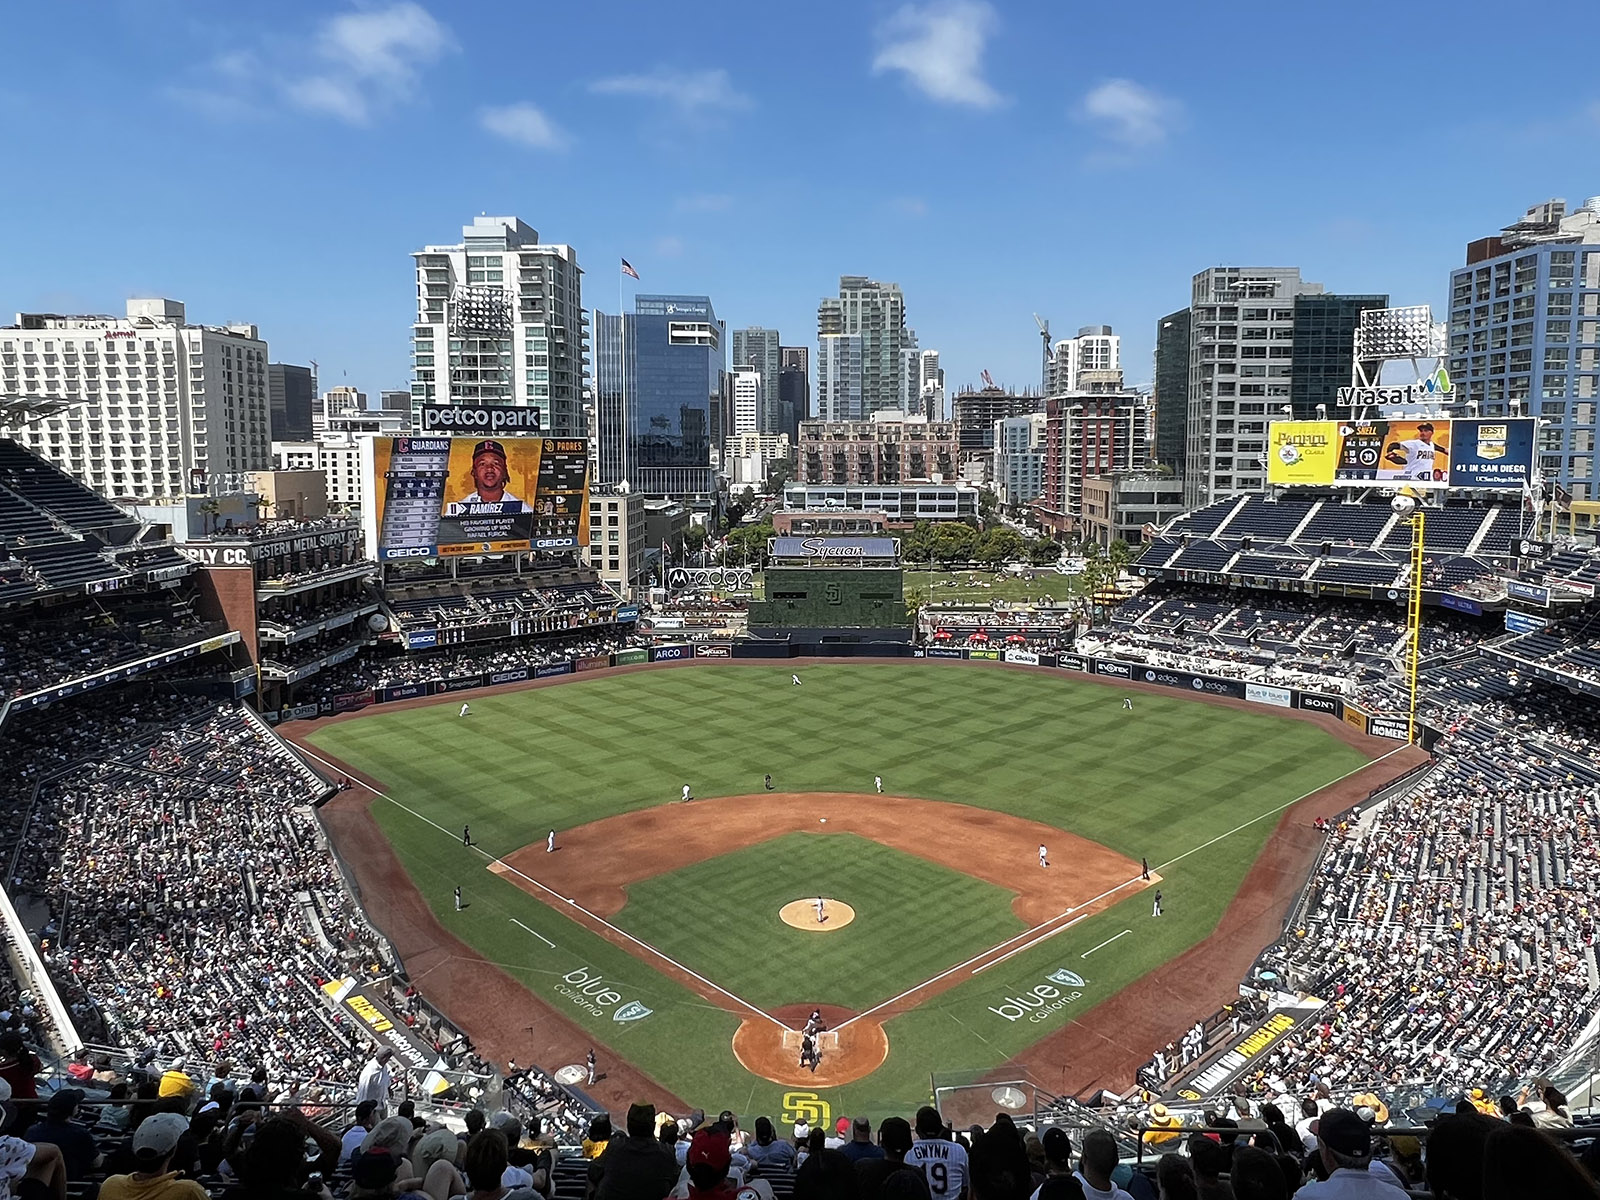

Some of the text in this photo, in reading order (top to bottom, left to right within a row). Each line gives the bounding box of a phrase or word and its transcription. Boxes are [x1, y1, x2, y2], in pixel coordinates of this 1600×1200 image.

[1341, 386, 1415, 405] Viasat
[425, 406, 538, 430] petco park
[1356, 427, 1376, 435] SNELL
[412, 441, 449, 450] GUARDIANS
[557, 441, 583, 451] PADRES
[1456, 464, 1466, 472] #1
[1480, 465, 1498, 473] SAN
[1500, 465, 1526, 473] DIEGO
[252, 529, 361, 560] WESTERN METAL SUPPLY CO.
[536, 538, 572, 548] GEICO
[800, 537, 863, 561] Sycuan
[223, 548, 251, 565] CO.
[387, 547, 430, 558] GEICO
[695, 566, 753, 592] edge
[617, 610, 638, 618] GEICO
[409, 635, 436, 644] GEICO
[656, 649, 681, 659] ARCO
[697, 646, 728, 658] Sycuan
[578, 658, 608, 671] illumina
[1015, 654, 1036, 663] ClickUp
[492, 670, 527, 683] GEICO
[537, 666, 564, 676] Southwest
[449, 679, 480, 689] Snapdragon
[1157, 673, 1178, 685] edge
[402, 687, 417, 695] bank
[1205, 681, 1227, 693] edge
[1247, 688, 1261, 696] blue
[1304, 698, 1334, 709] SONY
[294, 704, 315, 716] ORIS
[1372, 725, 1409, 740] HOMERS
[562, 966, 622, 1006] blue
[553, 983, 603, 1017] california
[987, 984, 1060, 1021] blue
[1029, 990, 1083, 1023] california
[385, 1028, 412, 1051] petco
[1189, 1063, 1232, 1093] THANK
[1218, 1049, 1248, 1071] YOU
[1235, 1027, 1276, 1058] PADRES
[1263, 1013, 1295, 1036] FANS
[913, 1145, 949, 1160] GWYNN
